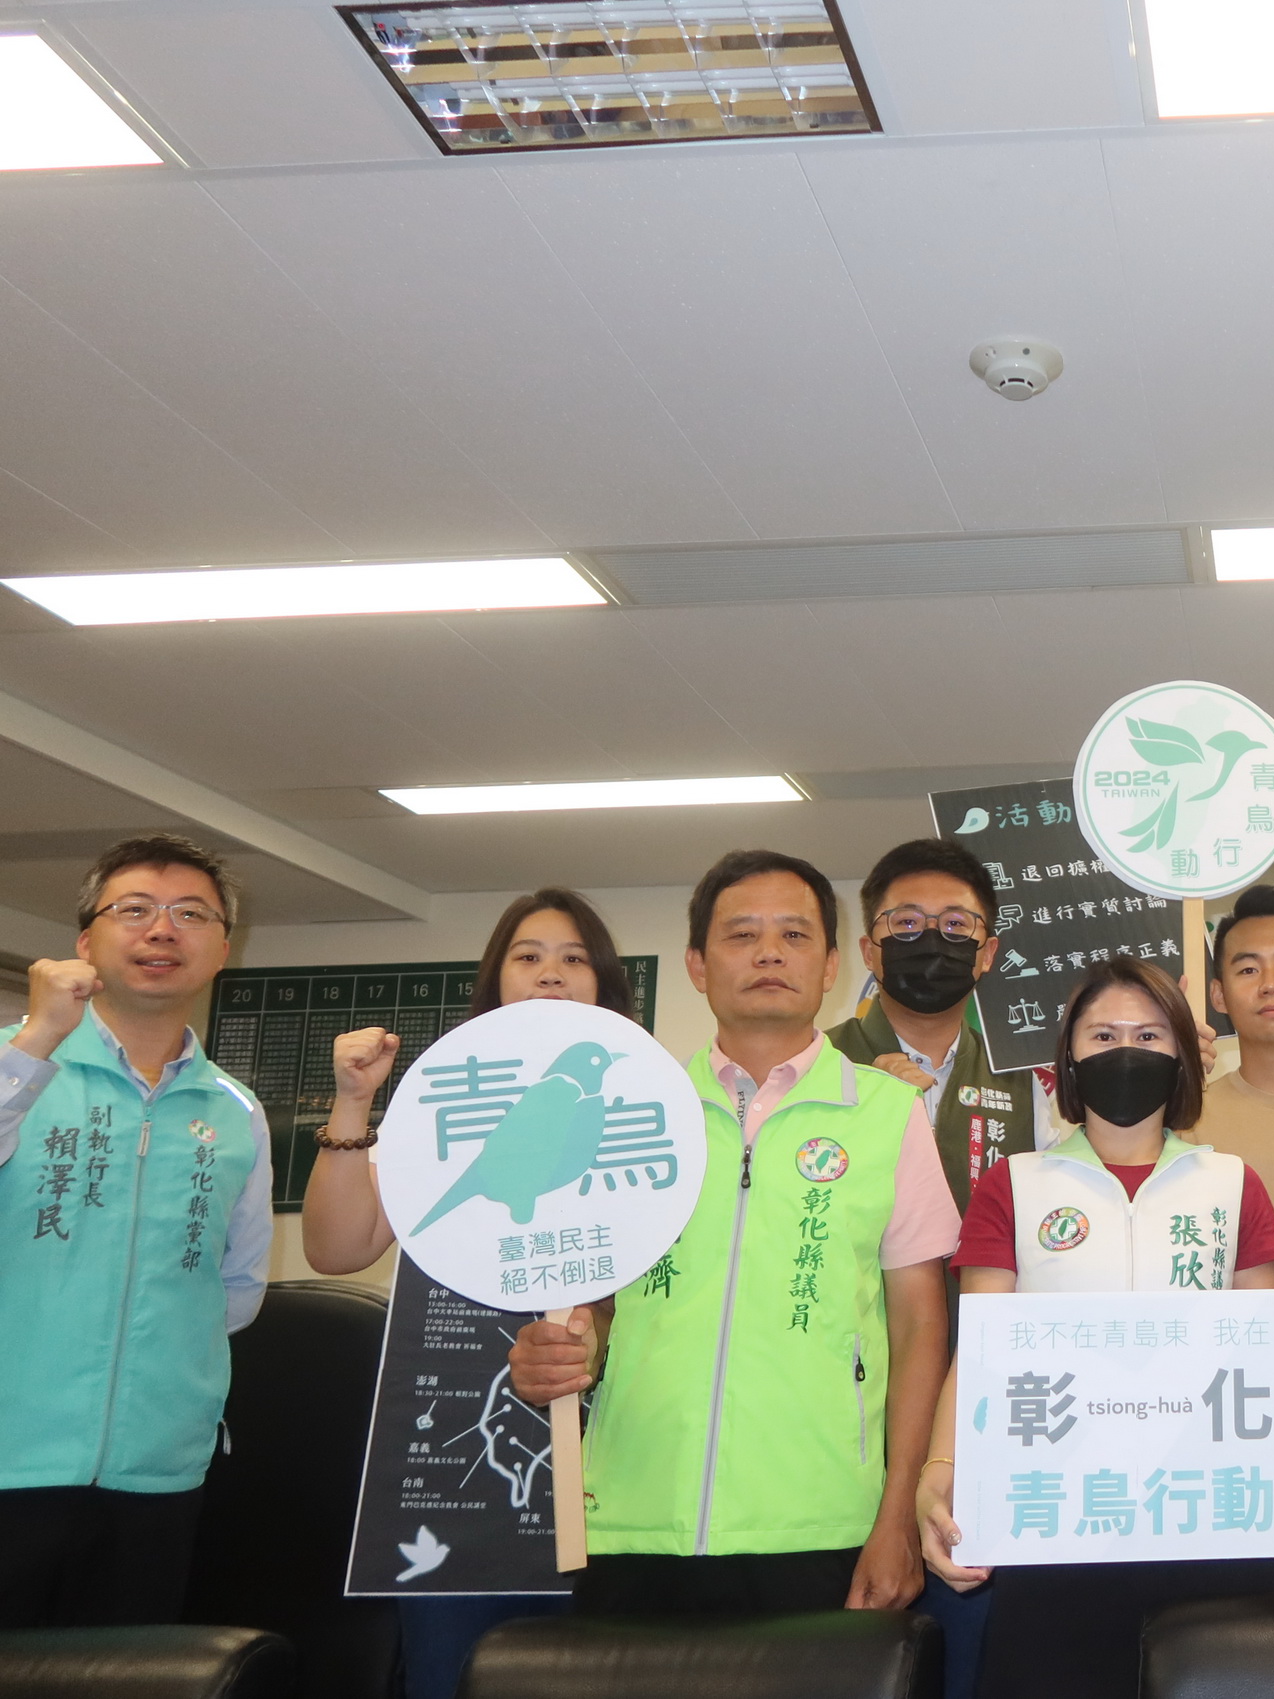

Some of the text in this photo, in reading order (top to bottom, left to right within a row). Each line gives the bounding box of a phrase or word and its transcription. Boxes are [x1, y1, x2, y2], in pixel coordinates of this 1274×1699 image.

[1094, 770, 1171, 787] 2024
[995, 799, 1072, 830] 活動
[1031, 894, 1167, 924] 進行實質討論
[232, 982, 474, 1003] 20 19 18 17 16 15
[418, 1055, 678, 1196] 青鳥
[83, 1105, 114, 1207] 副執行長
[33, 1126, 80, 1240] 賴澤民
[181, 1145, 215, 1272] 彰化縣黨部
[497, 1224, 614, 1262] 臺灣民主
[787, 1187, 832, 1333] 彰化縣議員
[1169, 1214, 1208, 1290] 張欣
[428, 1287, 450, 1299] 台中
[500, 1255, 616, 1296] 絕不倒退
[1008, 1319, 1190, 1351] 我不在青島東
[1213, 1317, 1271, 1347] 我在
[415, 1375, 439, 1387] 澎湖
[1005, 1367, 1273, 1447] 彰 tsiong-huà 化
[408, 1442, 430, 1454] 嘉義
[401, 1477, 425, 1488] 台南
[518, 1513, 542, 1524] 屏東
[1005, 1465, 1274, 1540] 青鳥行動
